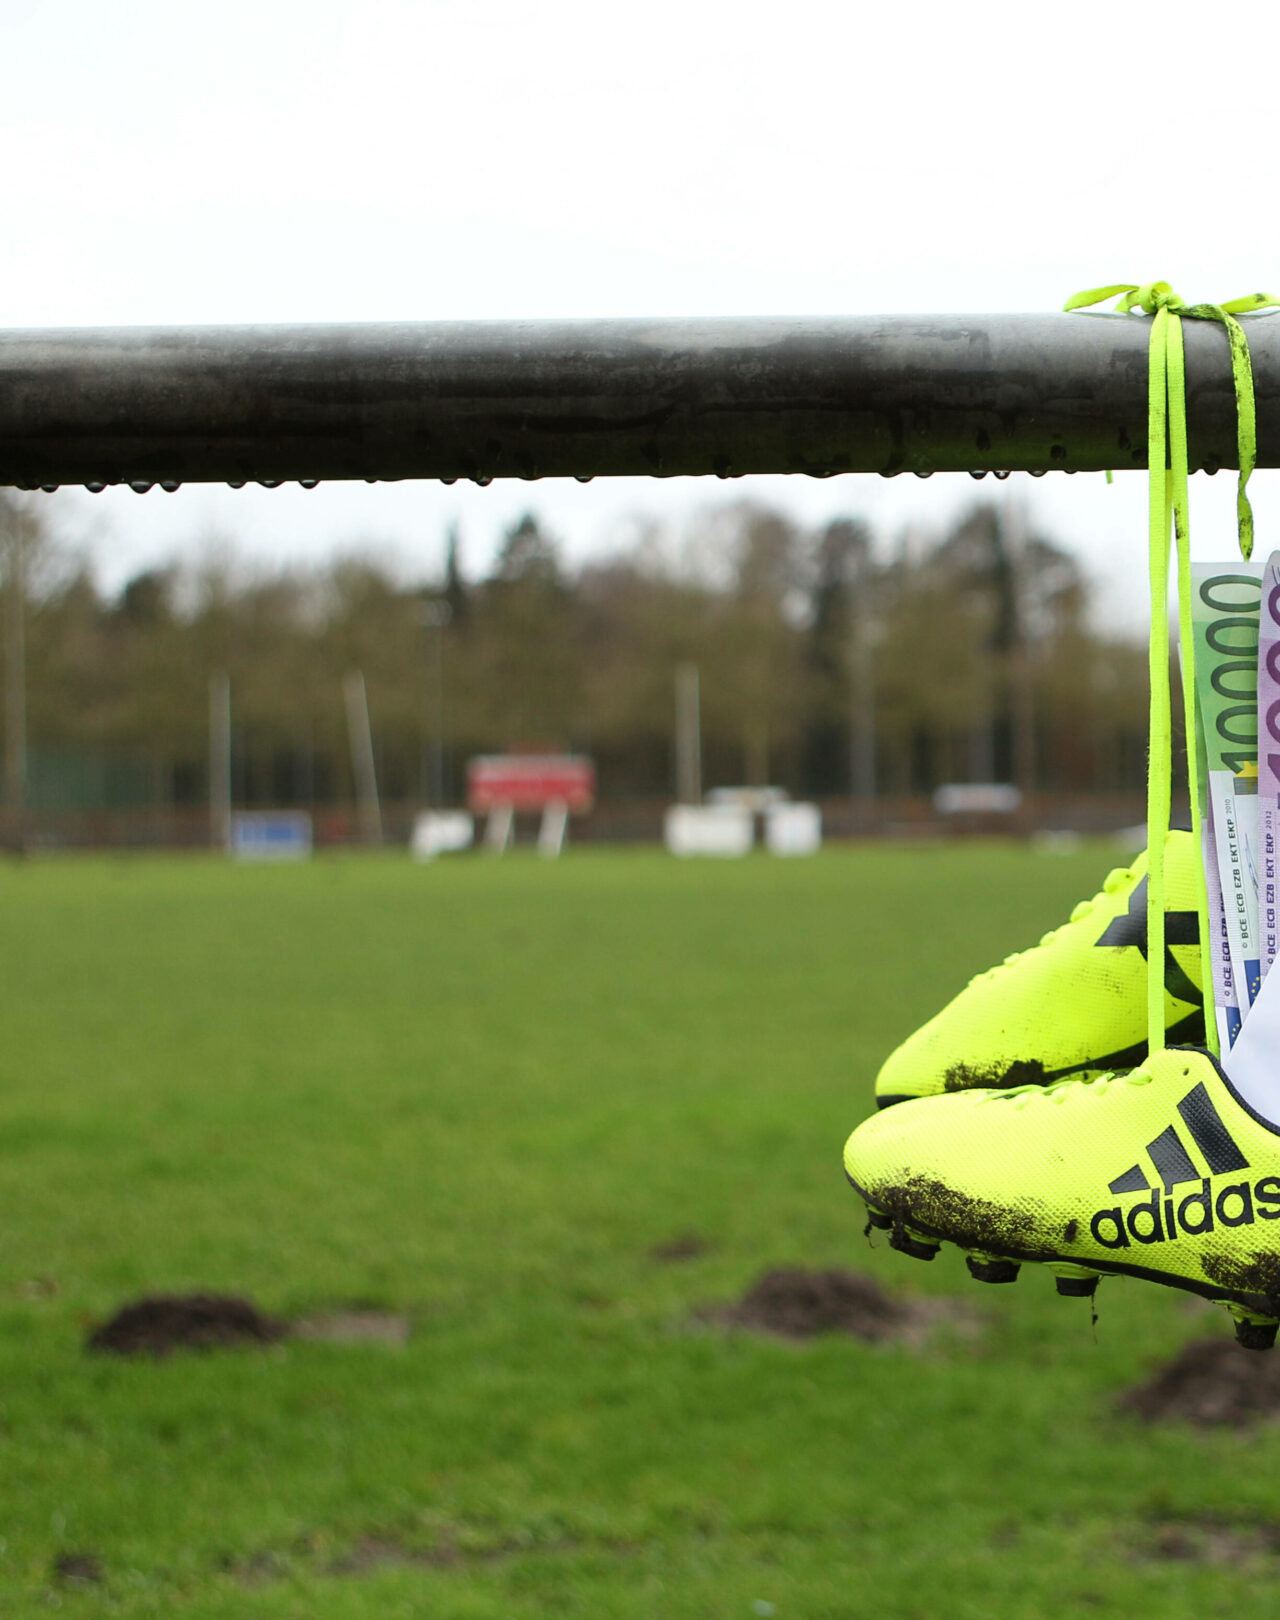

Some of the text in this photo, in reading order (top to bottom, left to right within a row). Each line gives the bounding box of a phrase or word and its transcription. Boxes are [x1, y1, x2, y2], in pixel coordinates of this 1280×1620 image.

[1199, 574, 1263, 775] 10000
[1227, 819, 1236, 839] EKP
[1229, 843, 1238, 863] EKT
[1265, 833, 1274, 854] EKP
[1266, 857, 1274, 878] EKT
[1233, 868, 1241, 888] EZB
[1236, 893, 1245, 913] ECB
[1266, 883, 1275, 904] EZB
[1267, 908, 1275, 928] ECB
[1239, 918, 1248, 939] BCE
[1222, 942, 1231, 961] ECB
[1267, 934, 1276, 954] BCE
[1223, 967, 1232, 987] BCE
